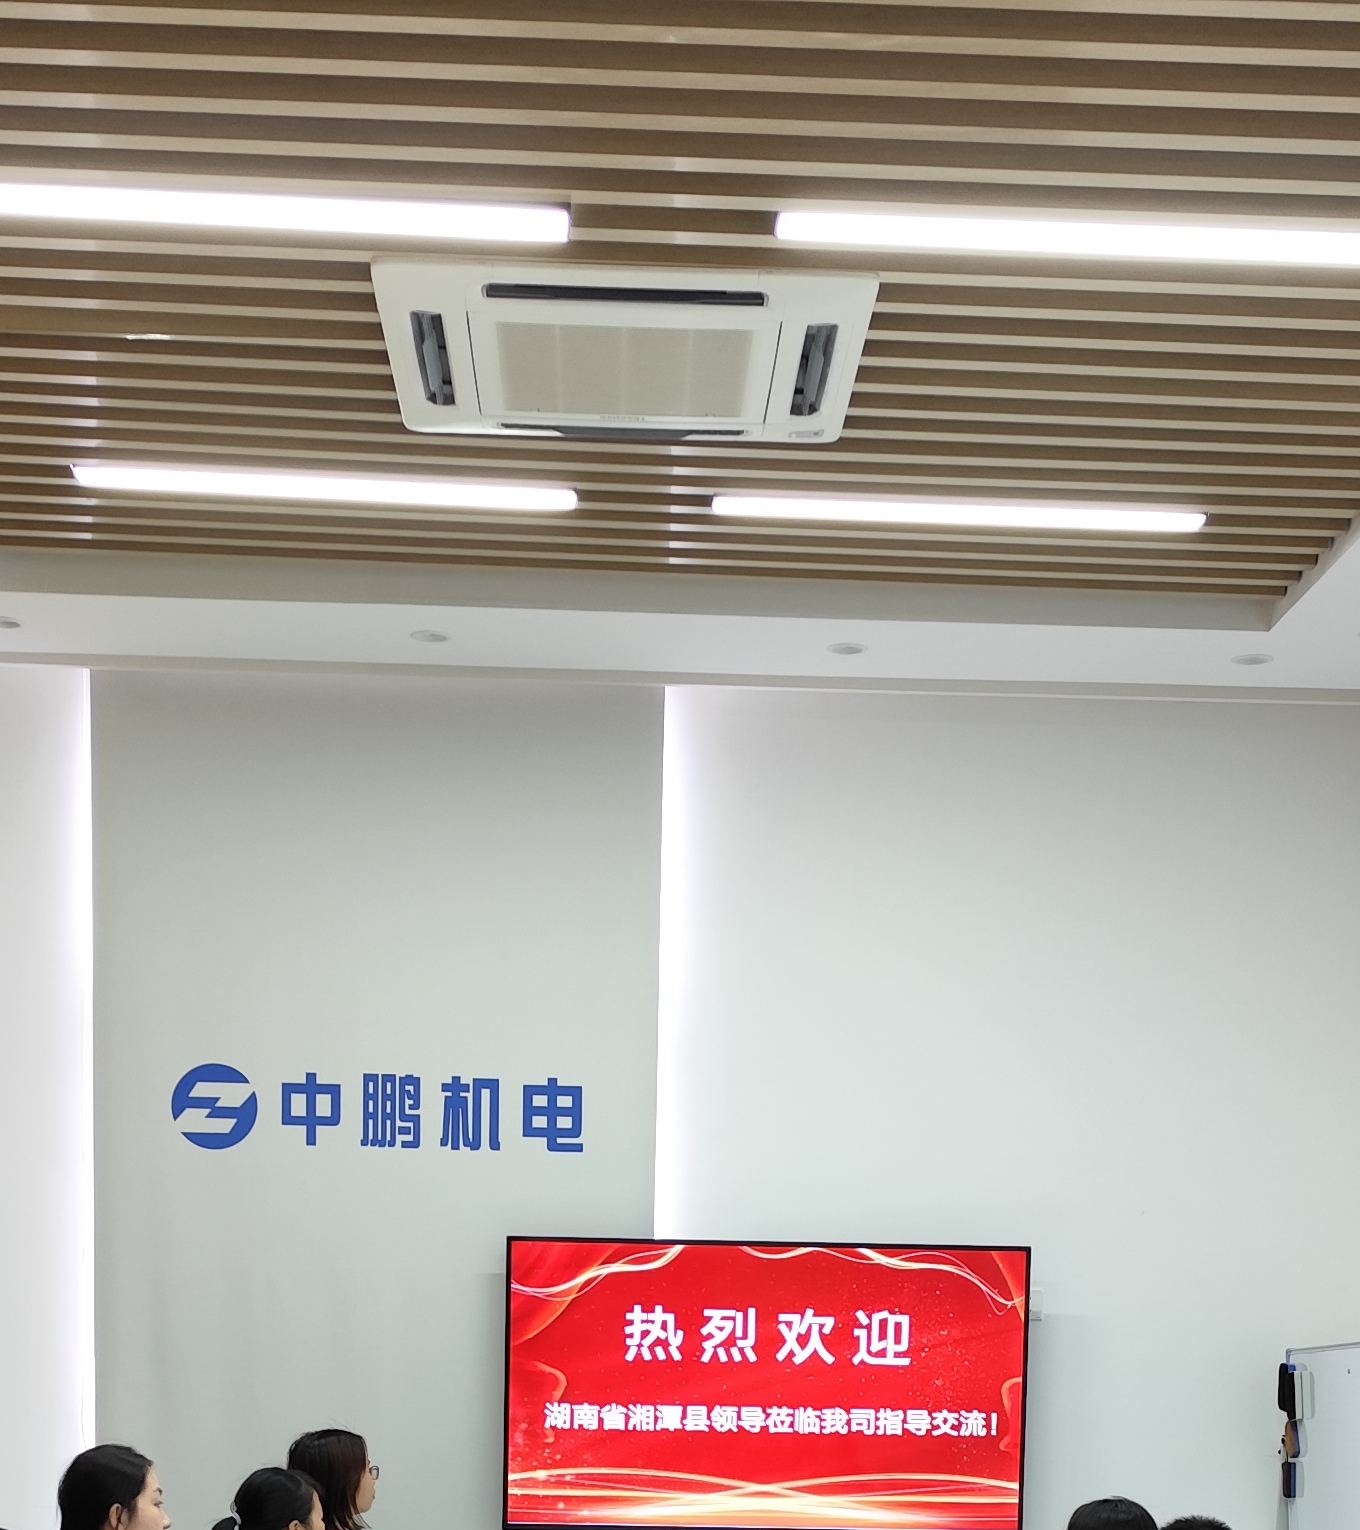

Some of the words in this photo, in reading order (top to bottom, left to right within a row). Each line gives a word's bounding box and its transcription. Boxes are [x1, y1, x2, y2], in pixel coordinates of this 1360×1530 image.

[281, 1072, 583, 1152] 中鹏机电
[623, 1304, 912, 1367] 热烈欢迎
